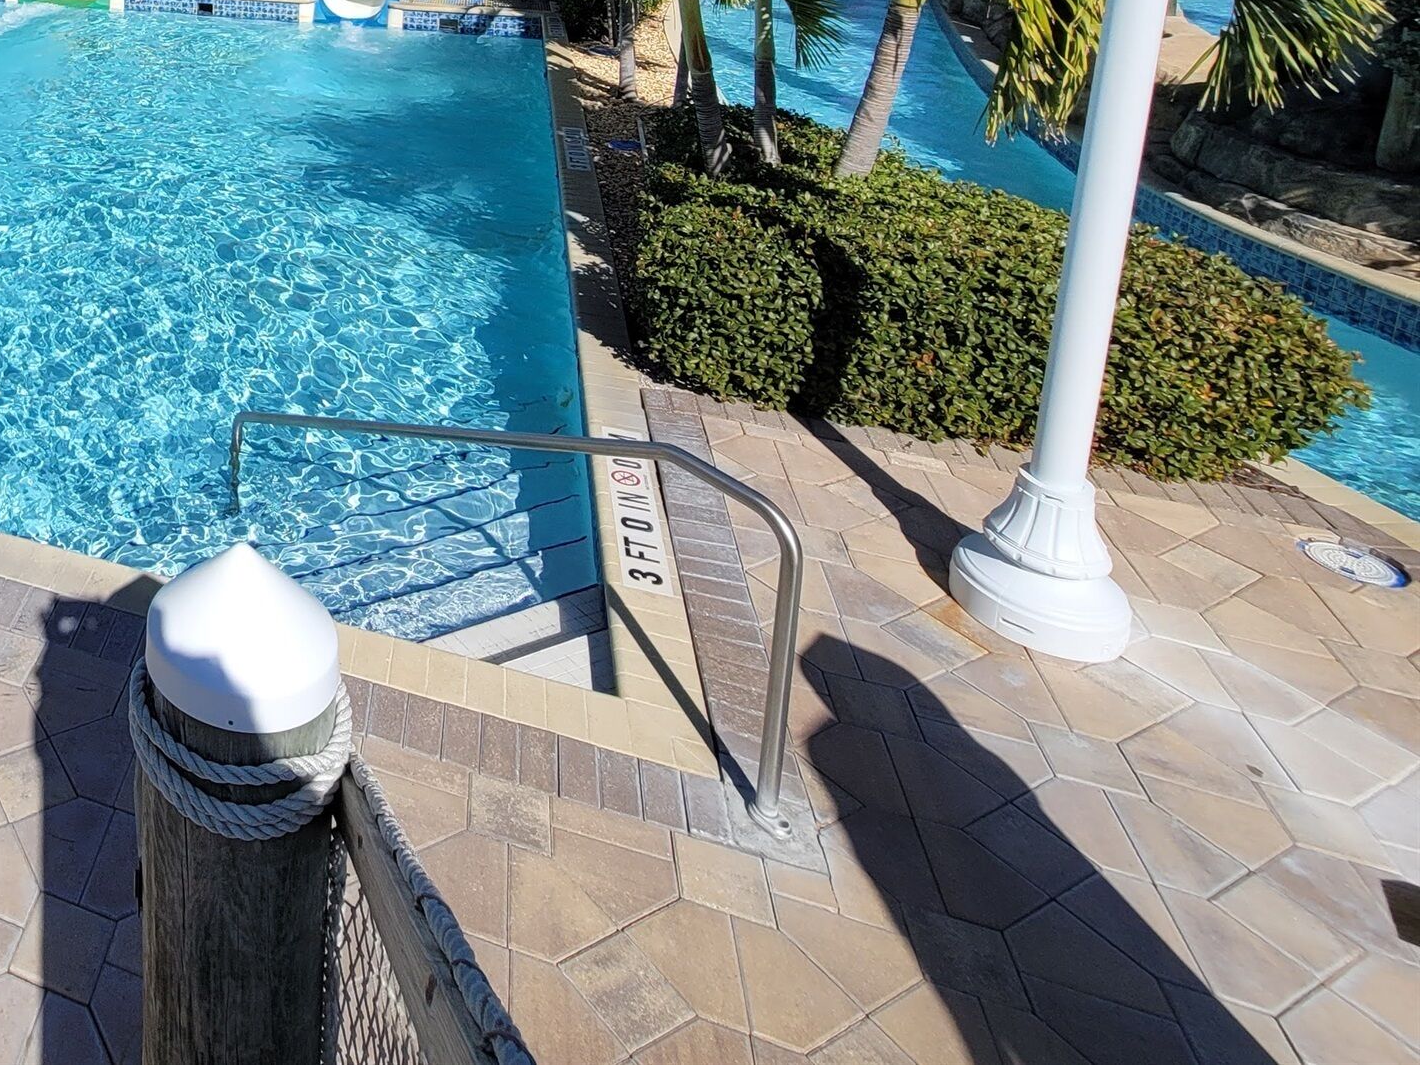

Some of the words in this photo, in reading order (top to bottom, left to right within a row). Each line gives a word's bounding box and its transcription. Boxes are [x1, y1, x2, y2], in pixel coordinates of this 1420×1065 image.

[616, 490, 651, 513] IN
[623, 536, 661, 564] FT
[628, 568, 664, 586] 3
